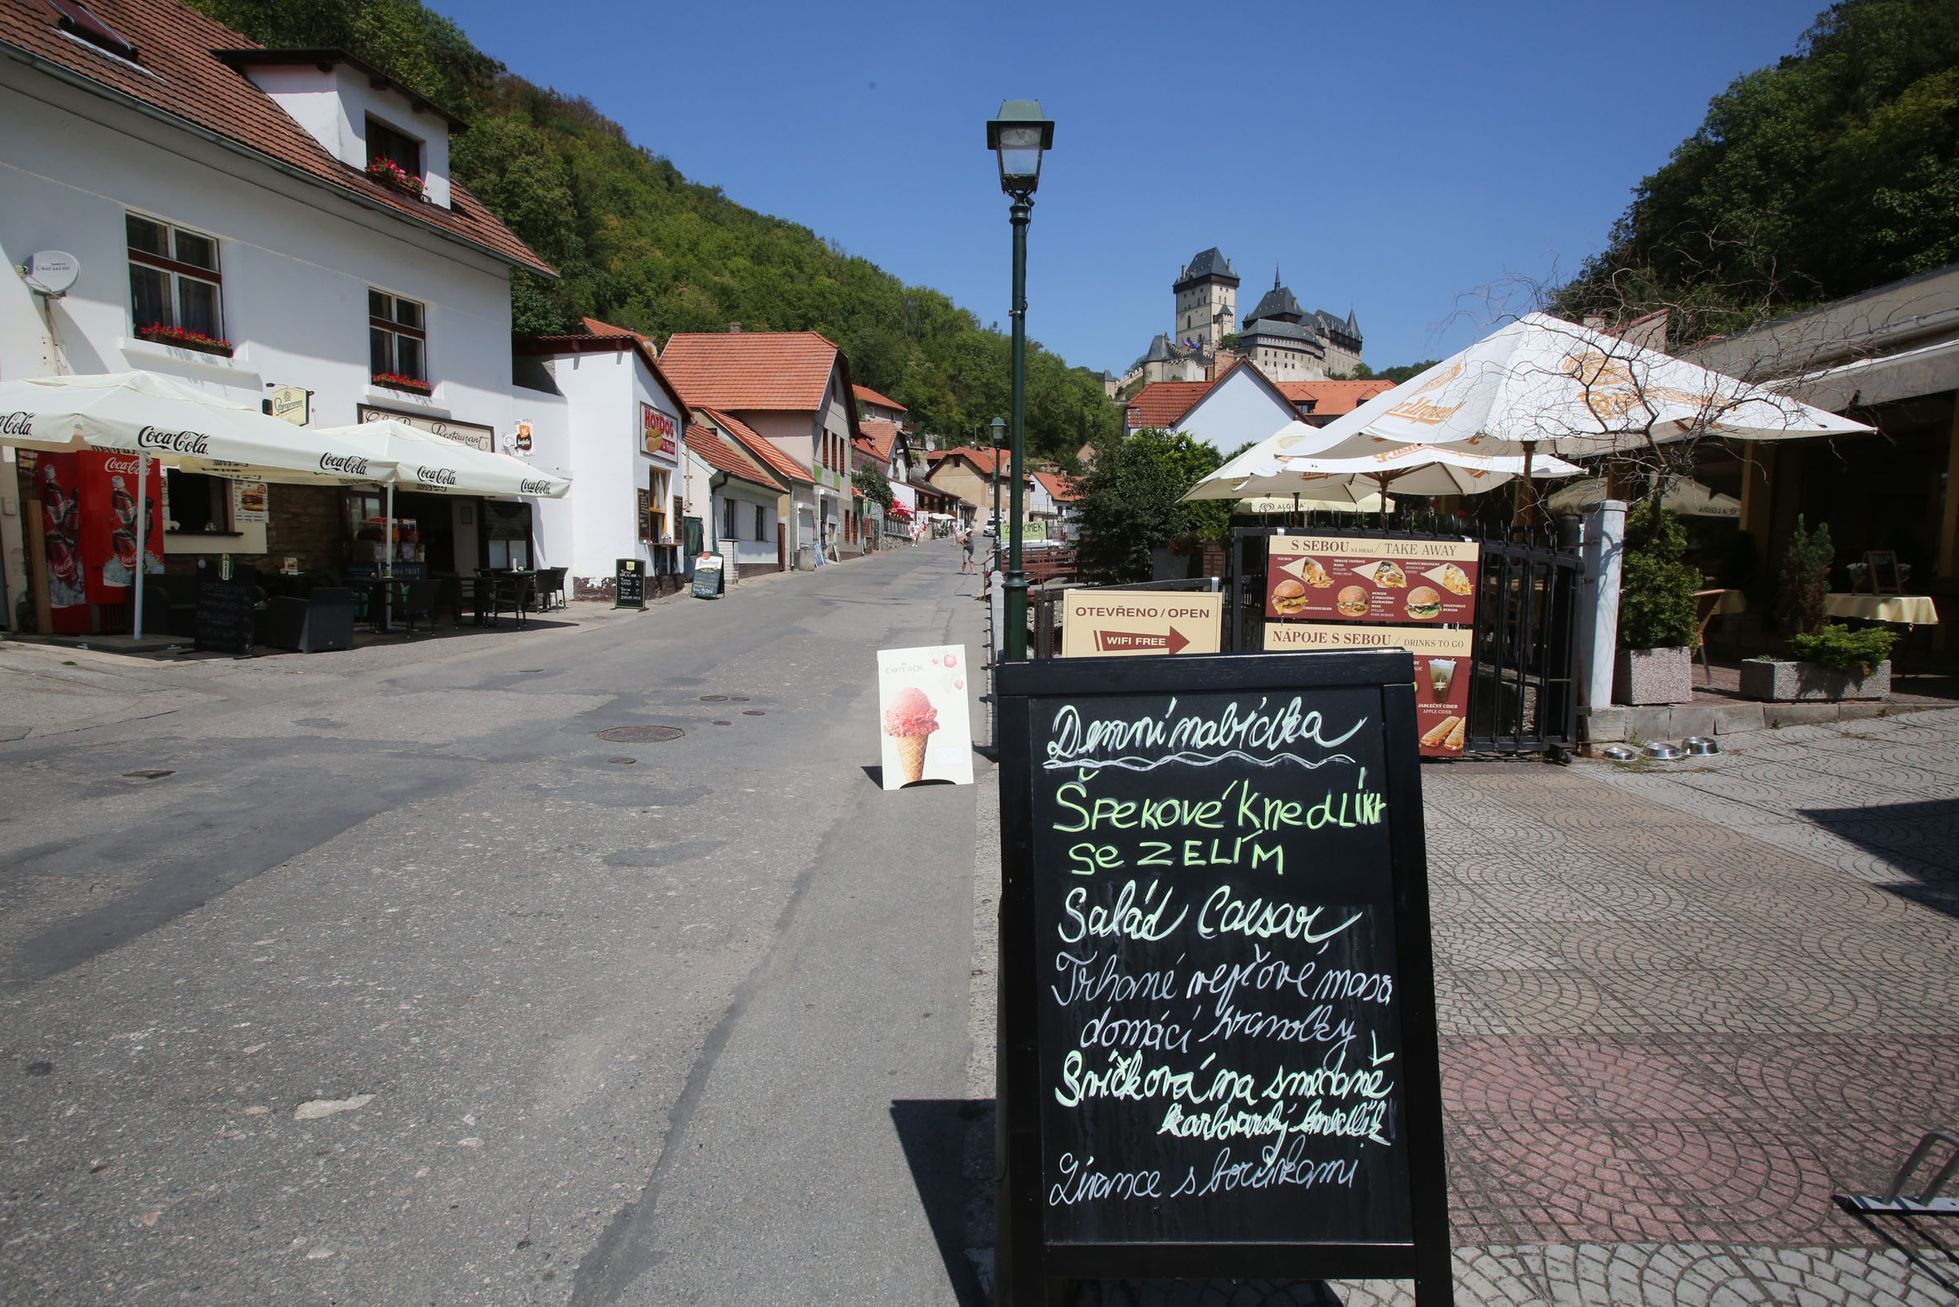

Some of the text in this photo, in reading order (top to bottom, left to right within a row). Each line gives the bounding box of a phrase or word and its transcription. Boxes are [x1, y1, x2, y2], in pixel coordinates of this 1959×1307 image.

[138, 425, 209, 454] Coca-Cola
[319, 451, 370, 476] Coca-Cola
[417, 465, 456, 486] Coca-Cola
[1291, 539, 1299, 551] S
[1302, 540, 1350, 553] SEBOU
[1384, 543, 1418, 555] TAKE
[1422, 544, 1457, 556] AWAY
[1075, 605, 1158, 618] OTEVŘENO
[1167, 608, 1210, 618] OPEN
[1106, 636, 1166, 646] WIFI FREE
[1273, 628, 1328, 644] NÁPOJE
[1331, 632, 1340, 644] S
[1343, 633, 1391, 646] SEBOU
[1403, 639, 1436, 647] DRINKS
[1437, 639, 1450, 648] TO
[1451, 640, 1464, 648] GO
[1136, 829, 1285, 875] ZELÍM
[1080, 1004, 1201, 1053] domácí
[1210, 1068, 1258, 1105] na
[1170, 1165, 1196, 1197] s
